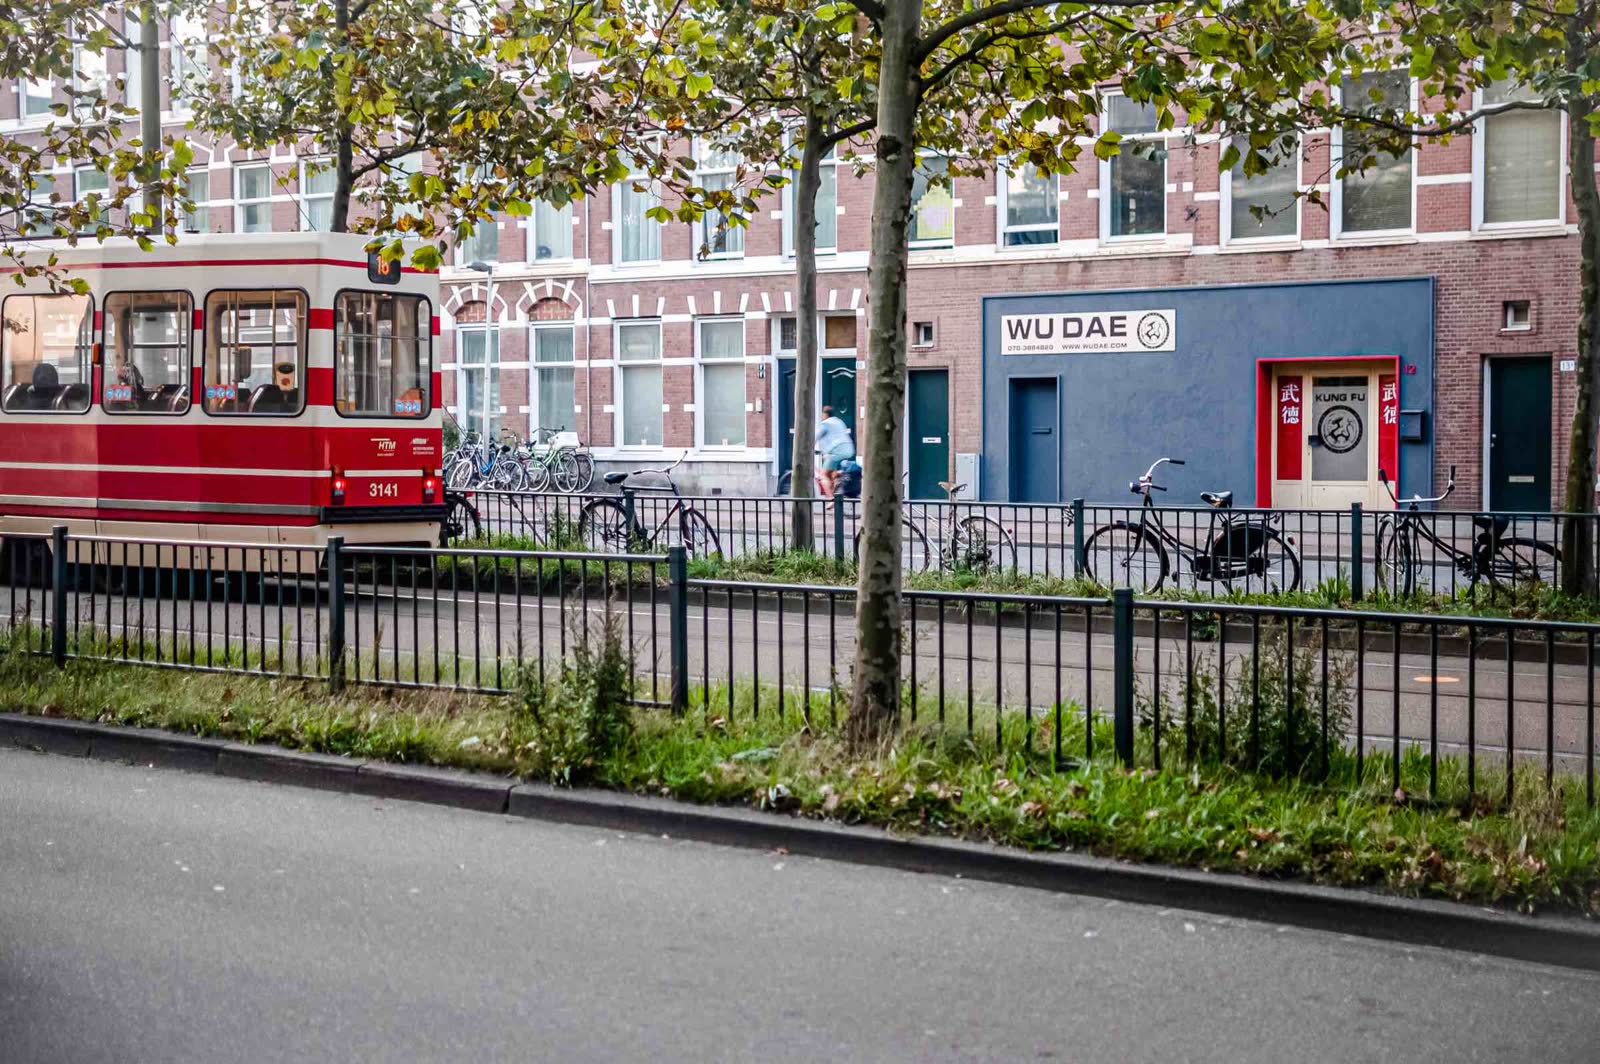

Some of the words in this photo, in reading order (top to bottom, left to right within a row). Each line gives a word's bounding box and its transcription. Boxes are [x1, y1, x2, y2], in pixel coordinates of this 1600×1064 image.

[1006, 318, 1054, 340] WU
[1062, 315, 1128, 339] DAE
[1403, 363, 1416, 375] 12
[1280, 383, 1300, 425] 武德
[1315, 393, 1348, 402] KUNG
[1350, 393, 1366, 402] FU
[378, 441, 396, 450] HTM
[369, 483, 398, 497] 3141
